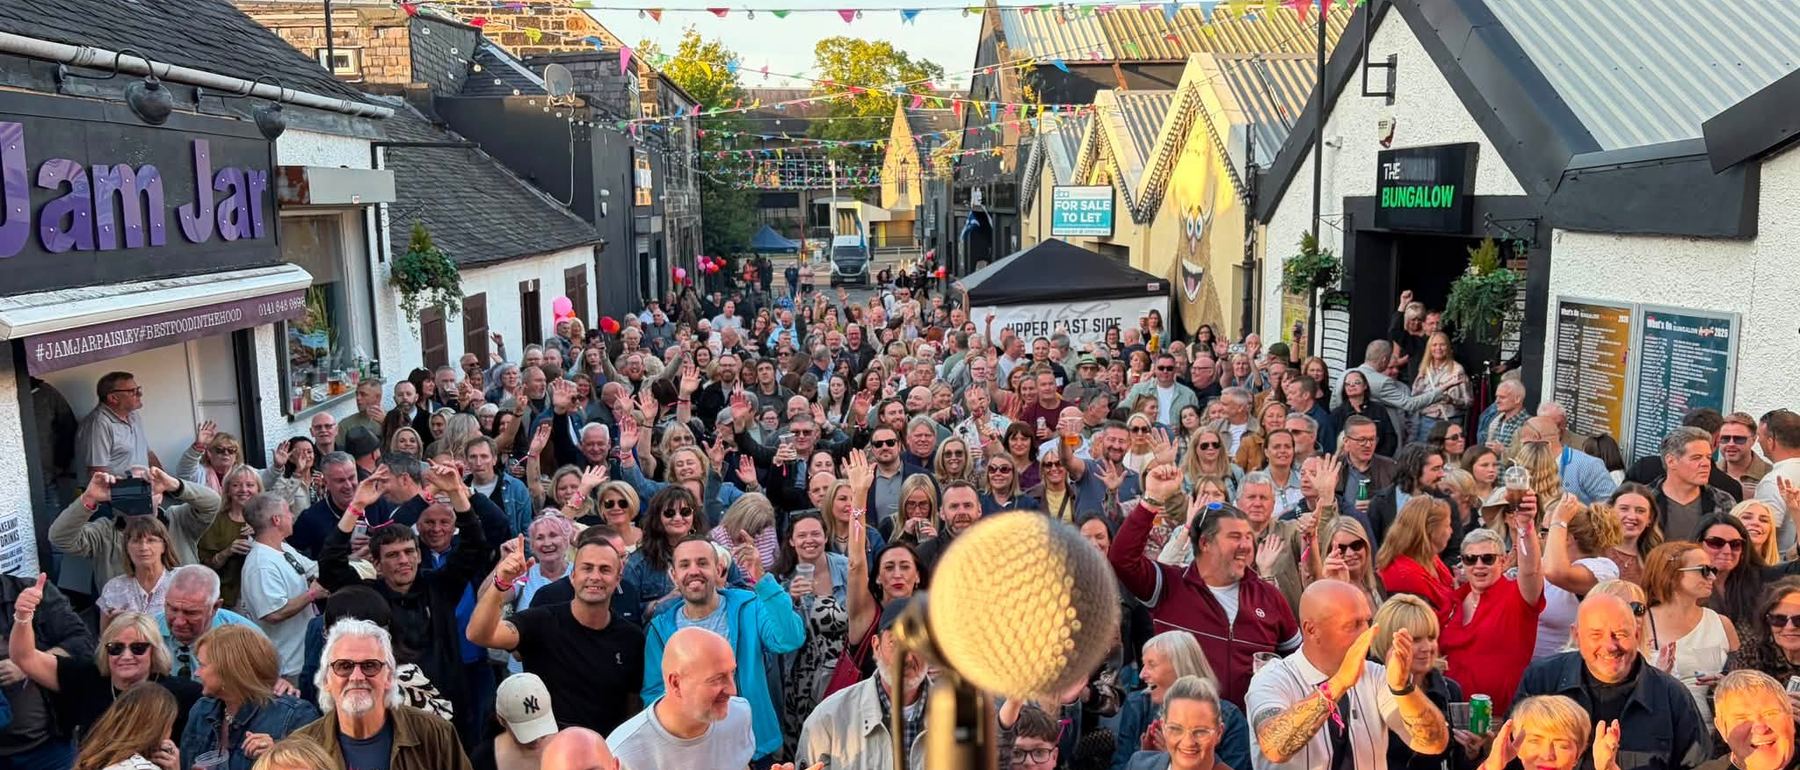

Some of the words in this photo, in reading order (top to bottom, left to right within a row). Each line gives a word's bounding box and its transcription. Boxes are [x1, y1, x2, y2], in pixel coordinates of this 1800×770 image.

[1383, 162, 1401, 180] THE
[0, 122, 166, 258] Jam
[178, 139, 267, 243] Jar
[1382, 185, 1454, 208] BUNGALOW
[1054, 200, 1078, 210] FOR
[1080, 201, 1111, 211] SALE
[1062, 212, 1078, 223] TO
[1080, 212, 1103, 223] LET
[259, 304, 275, 316] 0141
